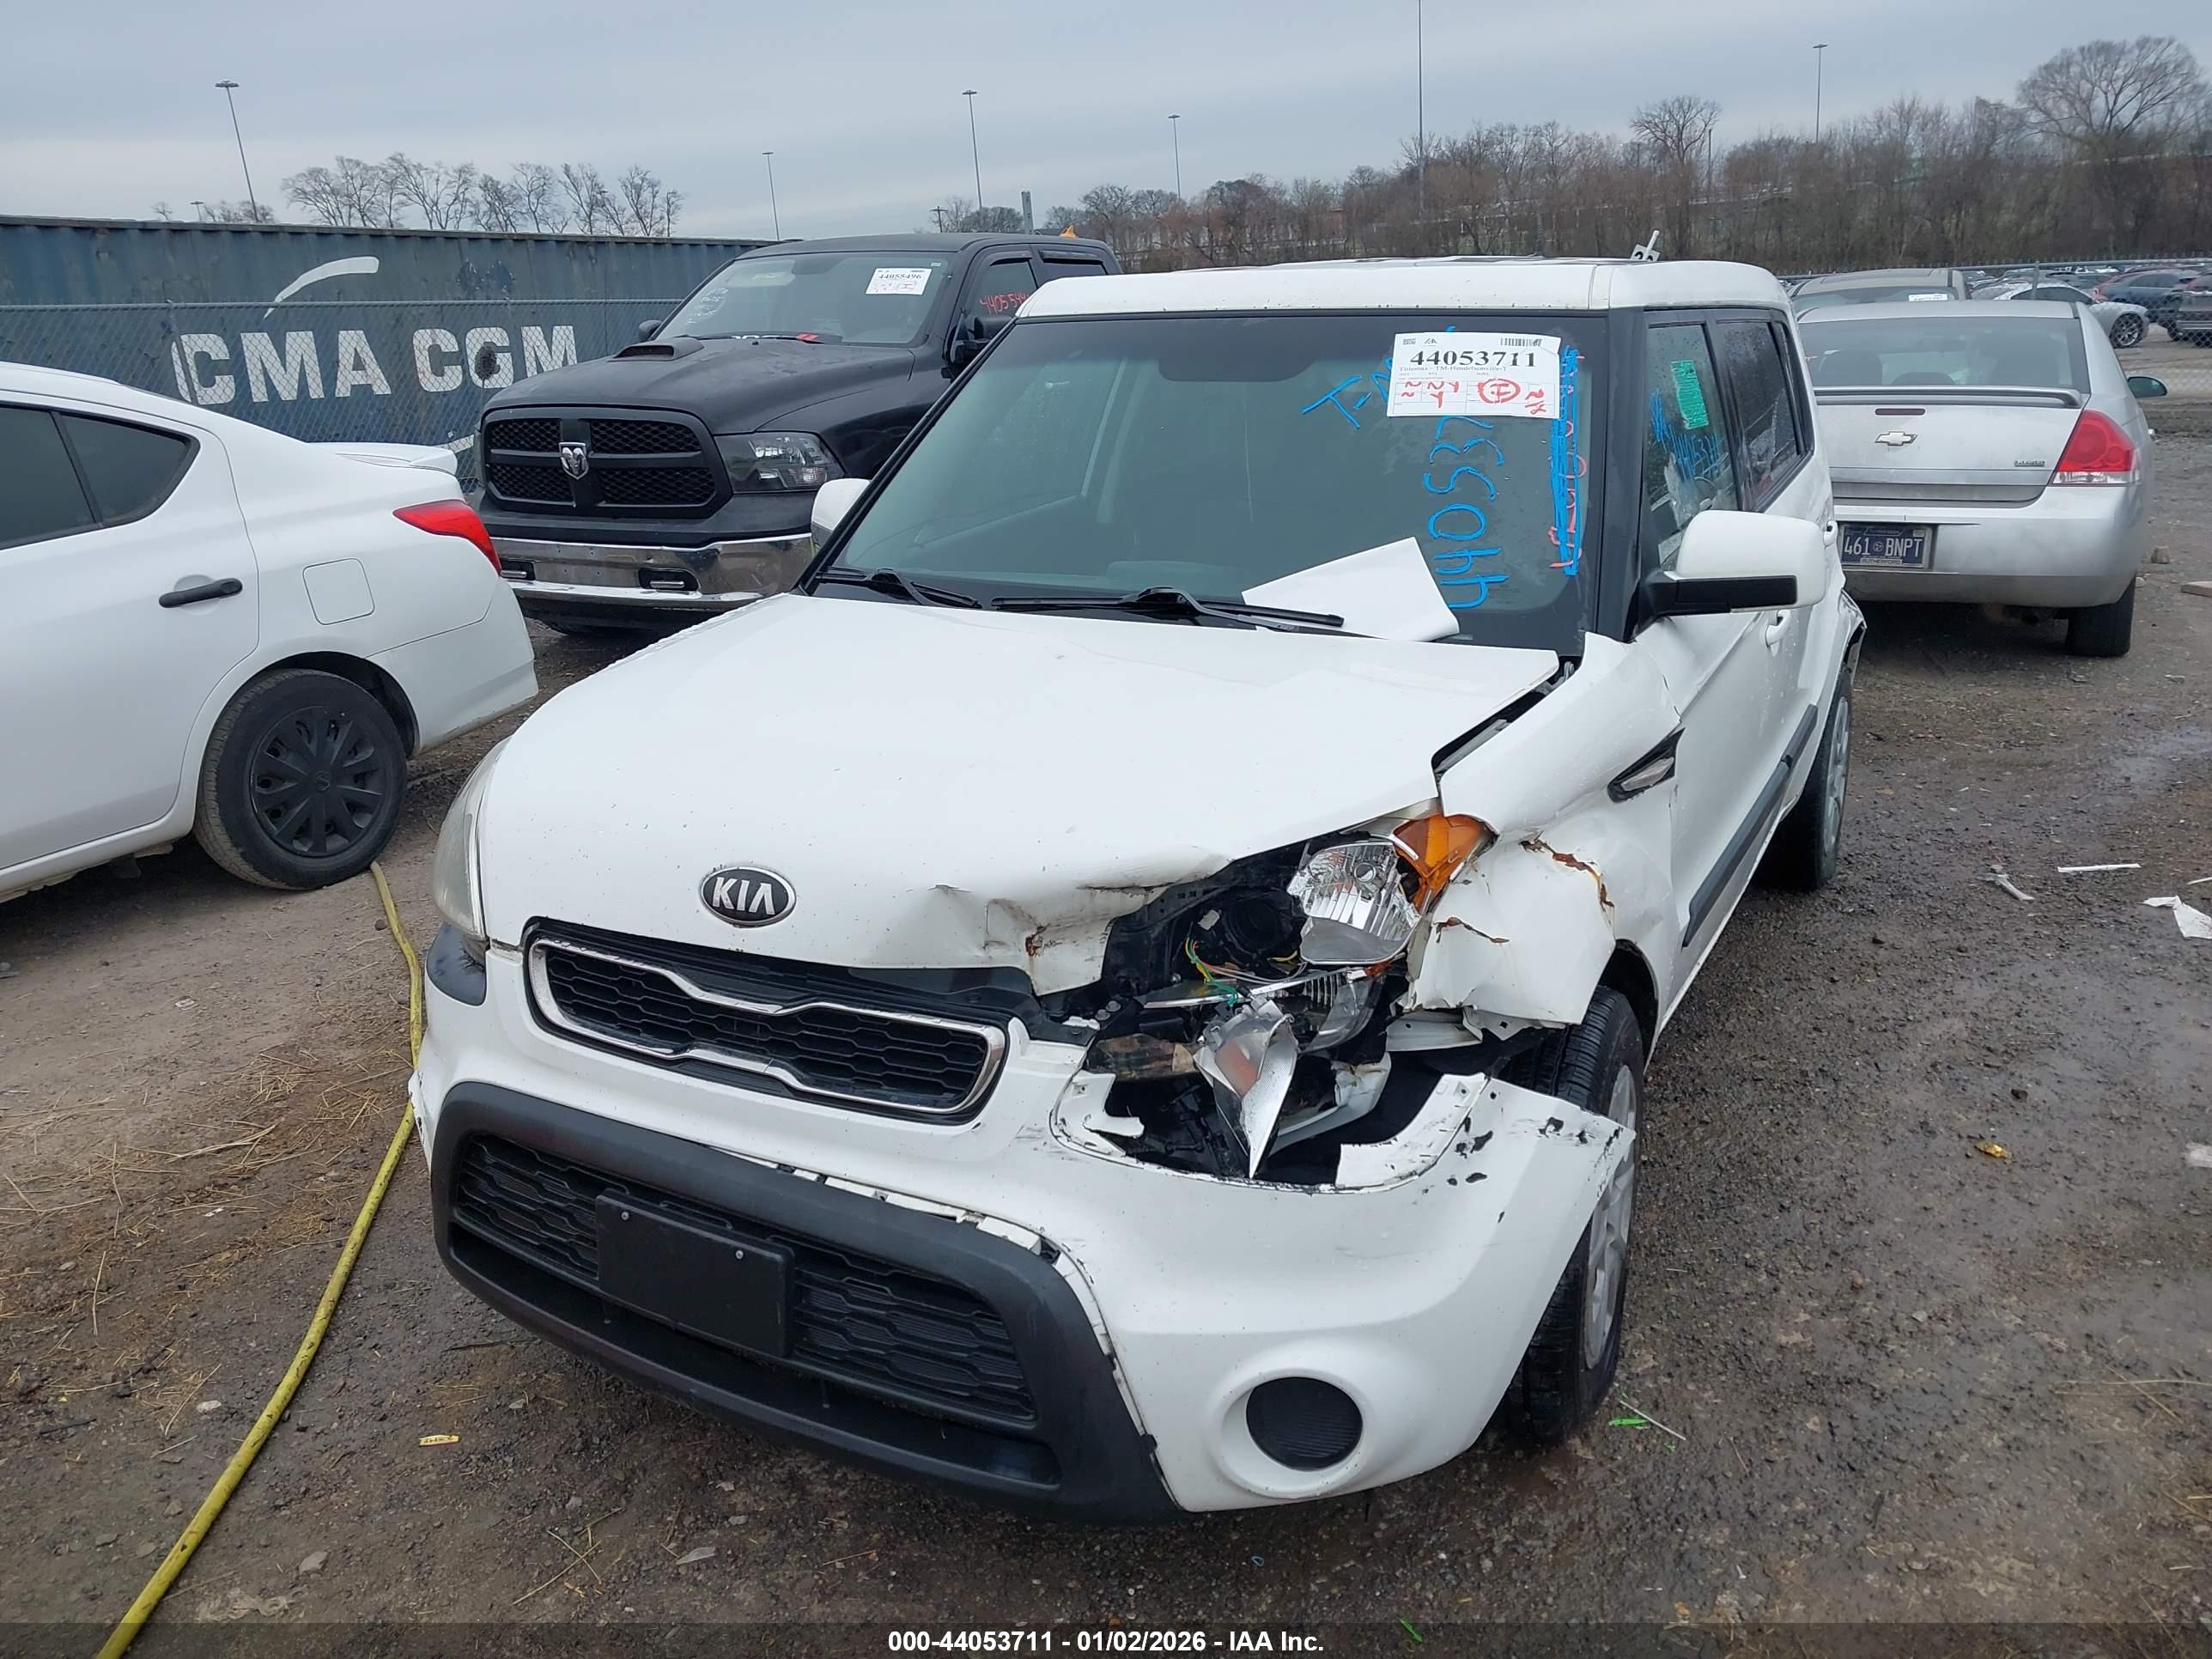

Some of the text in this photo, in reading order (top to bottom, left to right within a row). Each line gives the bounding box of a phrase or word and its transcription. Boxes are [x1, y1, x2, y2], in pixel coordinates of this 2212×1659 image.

[171, 325, 578, 405] CMA CGM
[1410, 350, 1536, 367] 44053711
[1844, 536, 1923, 557] 461 BNPT
[712, 877, 775, 915] KIA
